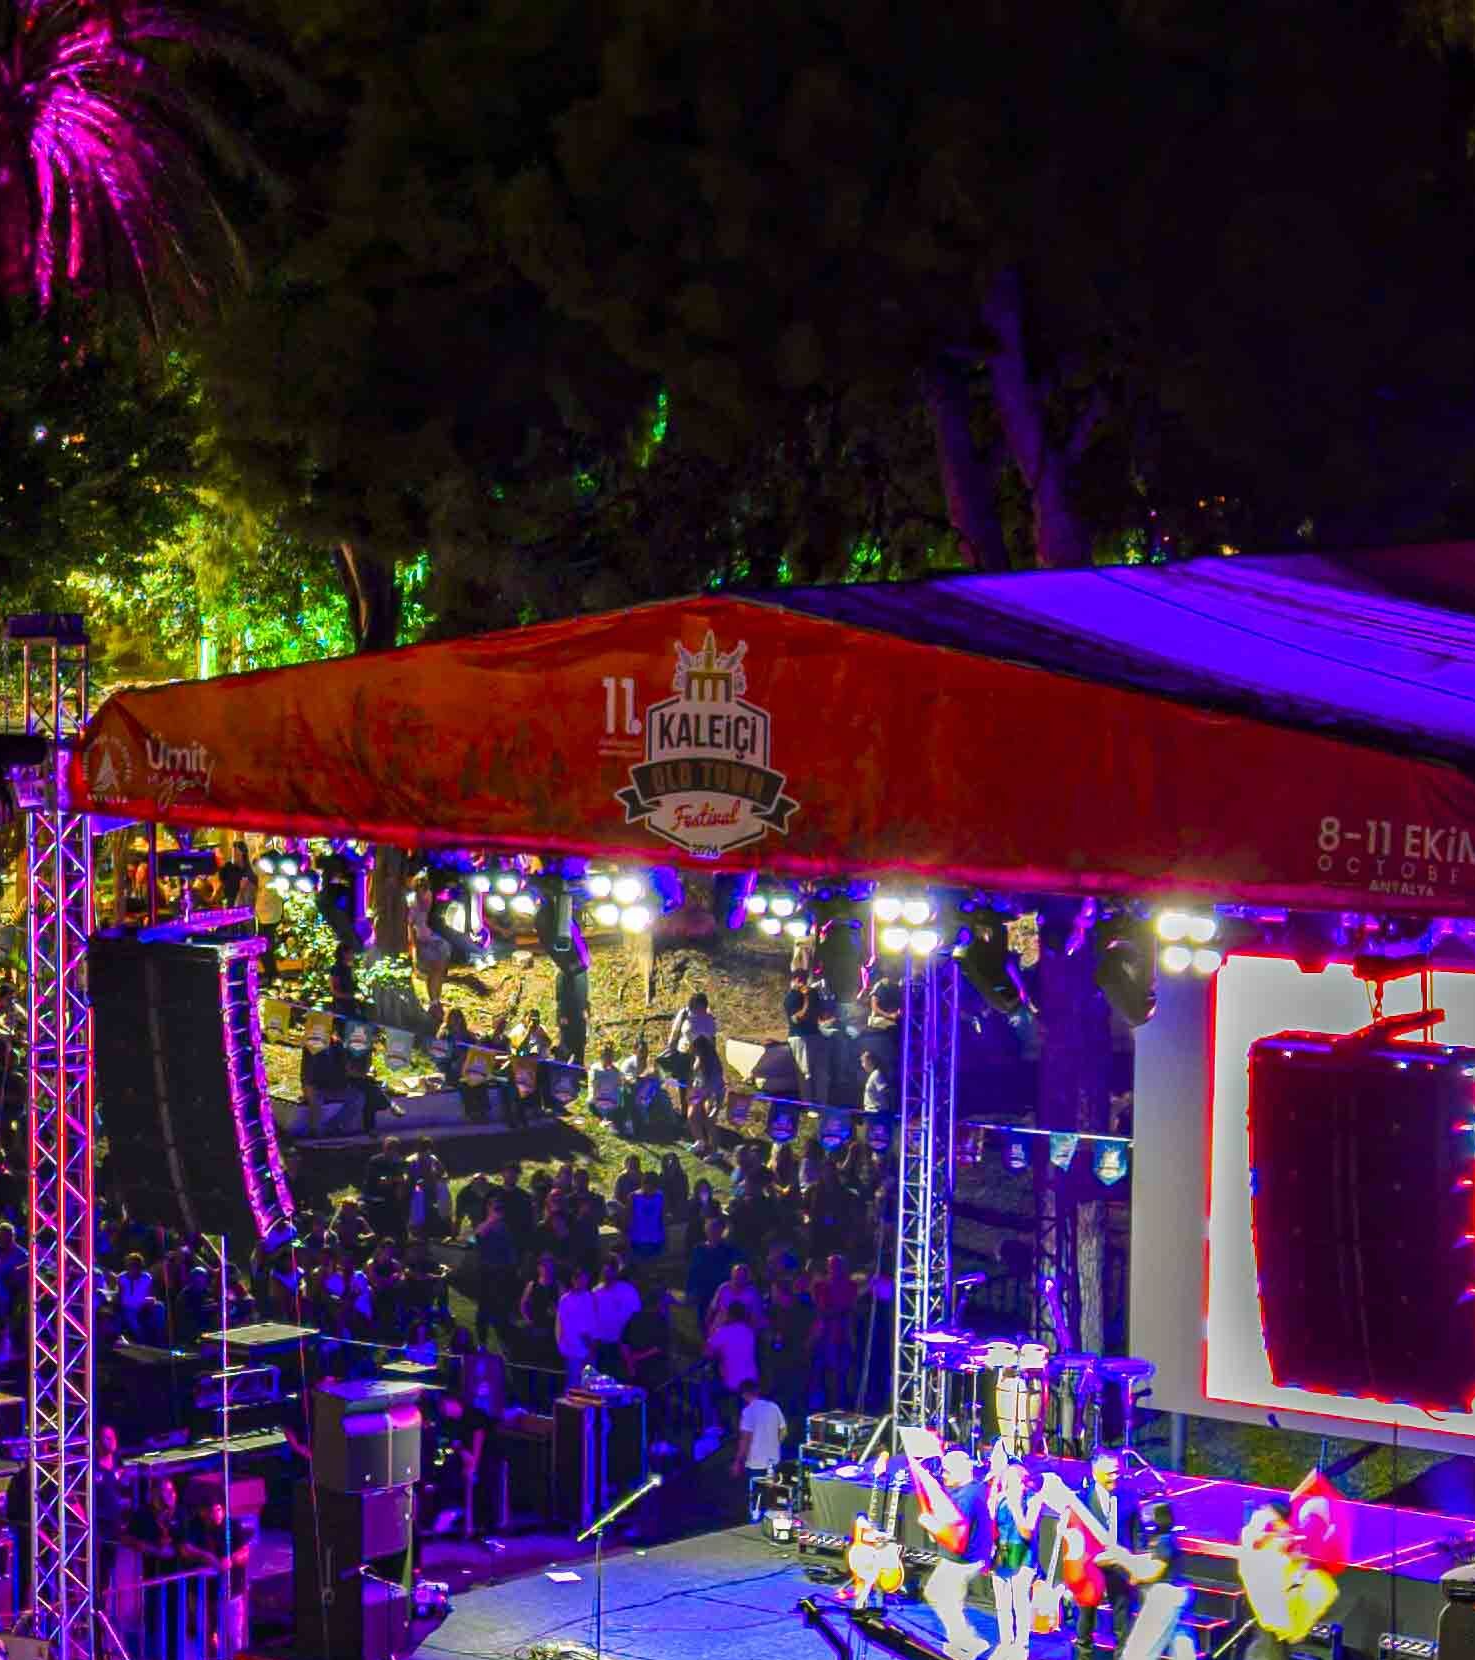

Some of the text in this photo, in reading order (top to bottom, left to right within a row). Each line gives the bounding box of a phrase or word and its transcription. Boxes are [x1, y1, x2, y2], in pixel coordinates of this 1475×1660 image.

[602, 676, 642, 735] 11.
[670, 800, 742, 832] Festival
[1317, 816, 1392, 855] 8-11
[1368, 878, 1435, 898] ANTALYA
